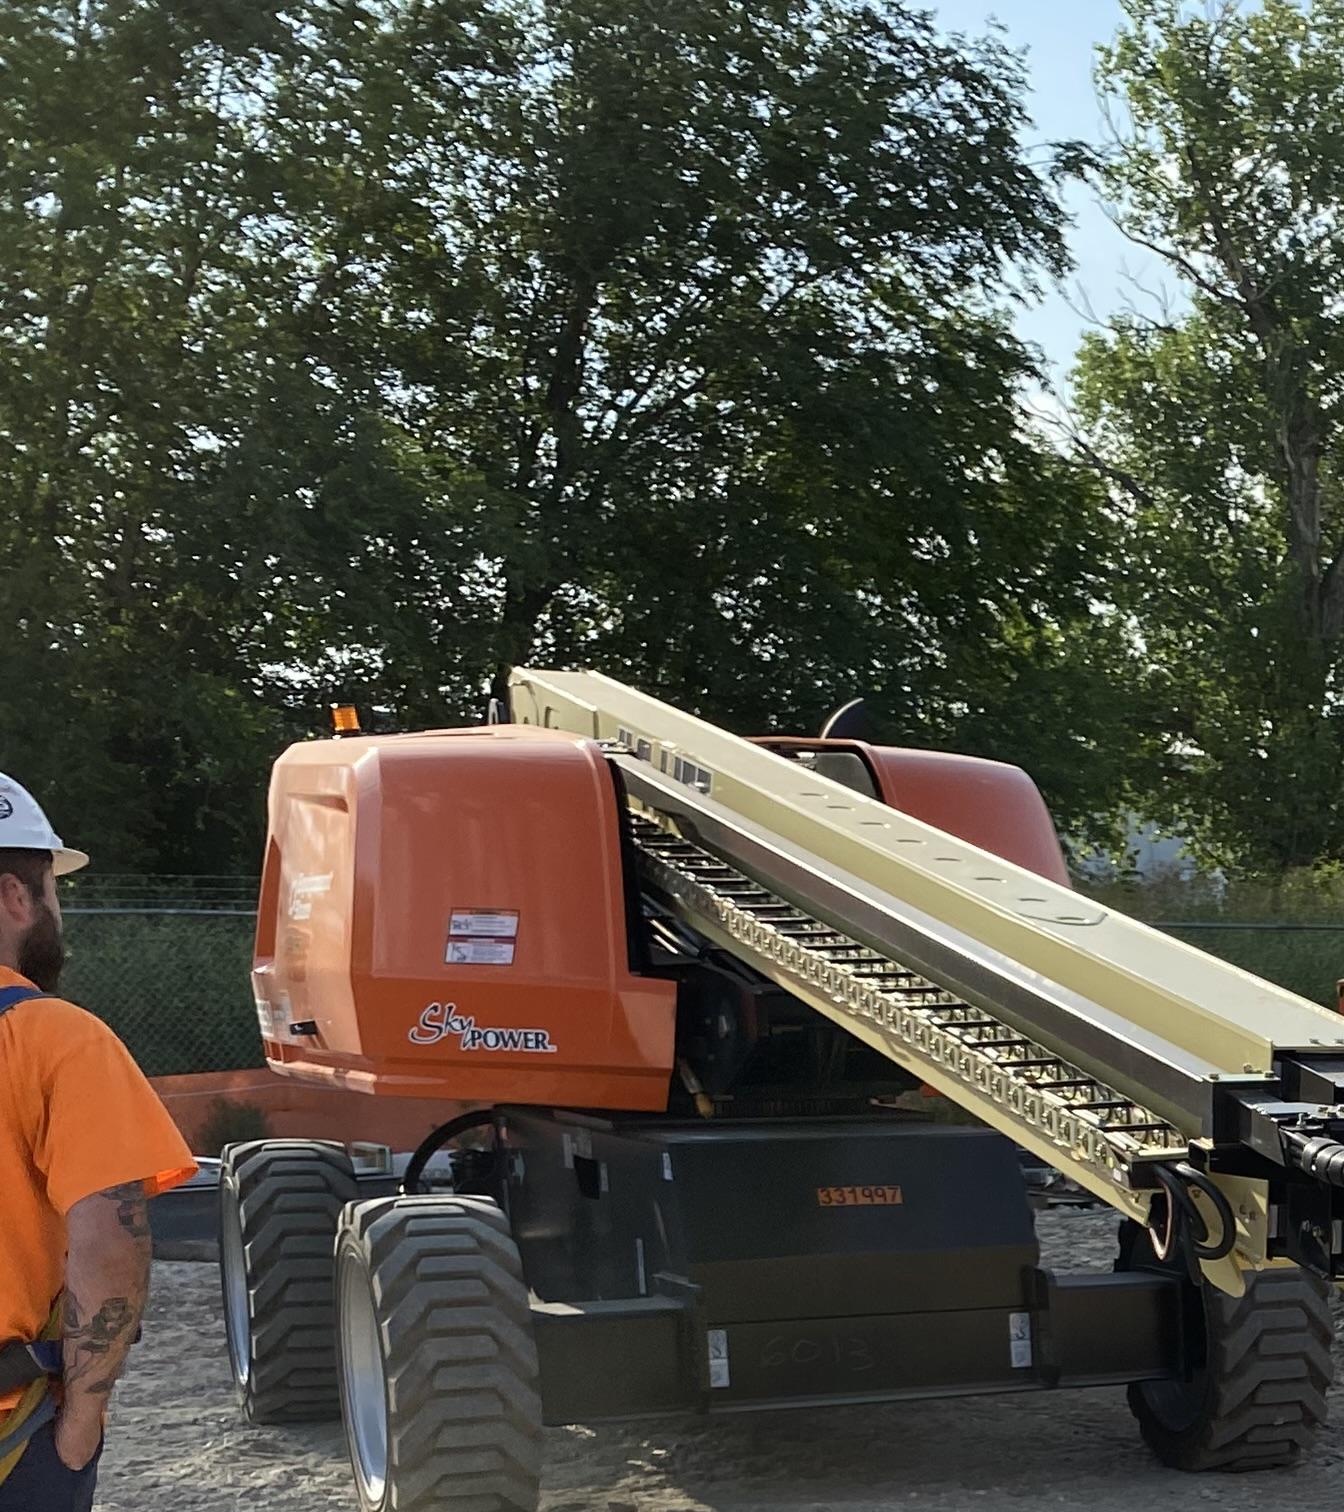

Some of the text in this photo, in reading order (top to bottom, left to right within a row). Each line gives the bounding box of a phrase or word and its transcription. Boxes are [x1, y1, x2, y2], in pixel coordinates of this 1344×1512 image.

[409, 1003, 550, 1051] Sky POWER
[819, 1186, 900, 1205] 331997
